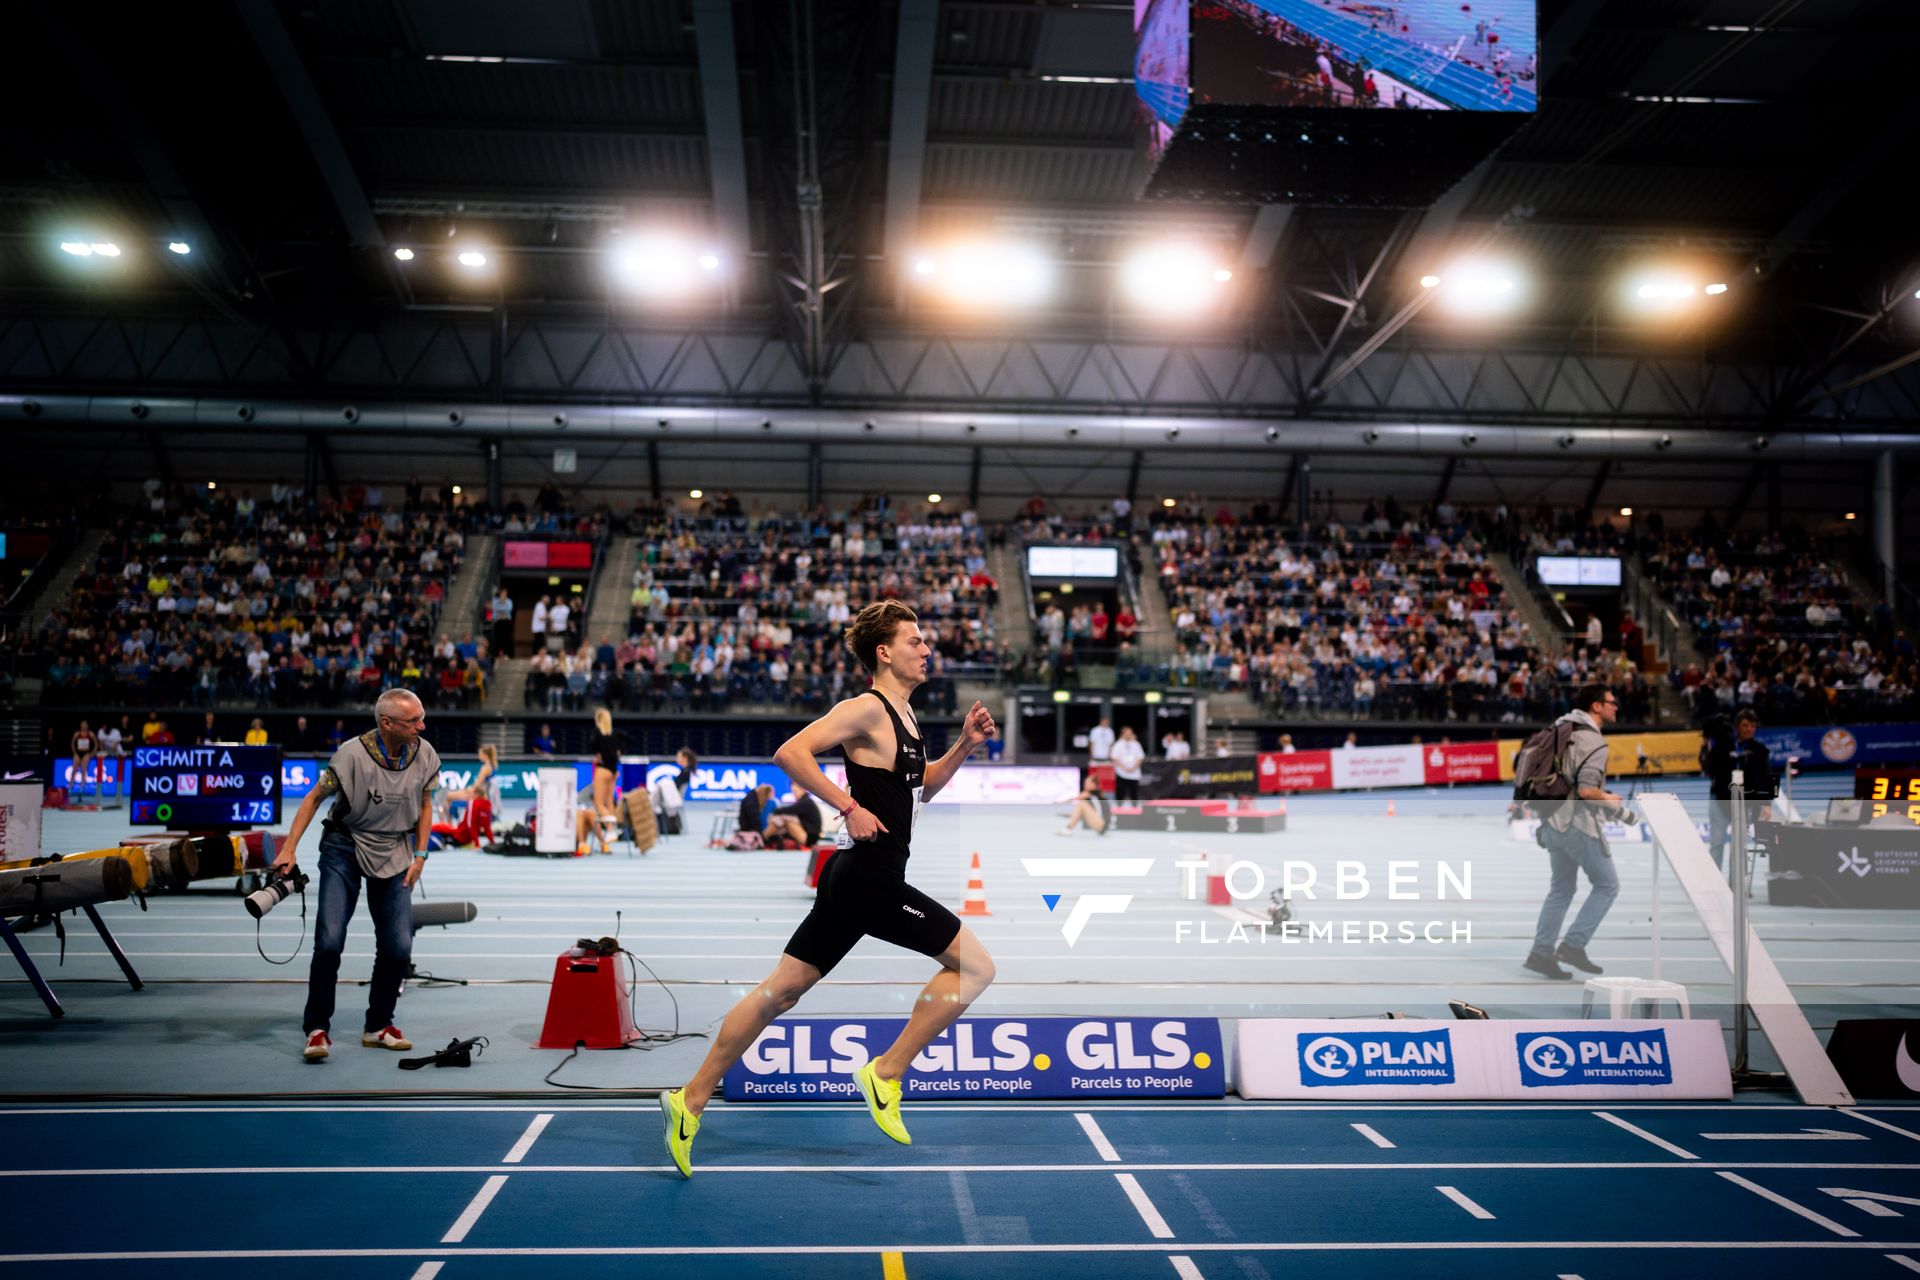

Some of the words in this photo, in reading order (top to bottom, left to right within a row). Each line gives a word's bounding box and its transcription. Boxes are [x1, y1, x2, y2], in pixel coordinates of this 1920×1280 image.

[136, 749, 215, 767] SCHMITT
[219, 750, 234, 767] A
[1447, 754, 1495, 766] Sparkasse
[281, 767, 310, 785] LS.
[1279, 763, 1326, 775] Sparkasse
[145, 776, 173, 793] NO
[206, 775, 245, 788] RANG
[261, 775, 274, 795] 9
[690, 769, 758, 790] PLAN
[232, 803, 271, 821] 1.75
[903, 905, 921, 916] CRAFT
[1362, 1041, 1447, 1065] PLAN
[1581, 1041, 1664, 1065] PLAN
[1365, 1068, 1449, 1078] INTERNATIONAL
[1584, 1068, 1666, 1078] INTERNATIONAL
[744, 1080, 797, 1094] Parcels
[801, 1082, 816, 1094] to
[820, 1081, 861, 1096] Peop
[909, 1079, 962, 1092] Parcels
[965, 1081, 980, 1092] to
[983, 1078, 1032, 1094] People
[1071, 1077, 1123, 1090] Parcels
[1127, 1078, 1141, 1089] to
[1145, 1076, 1193, 1092] People
